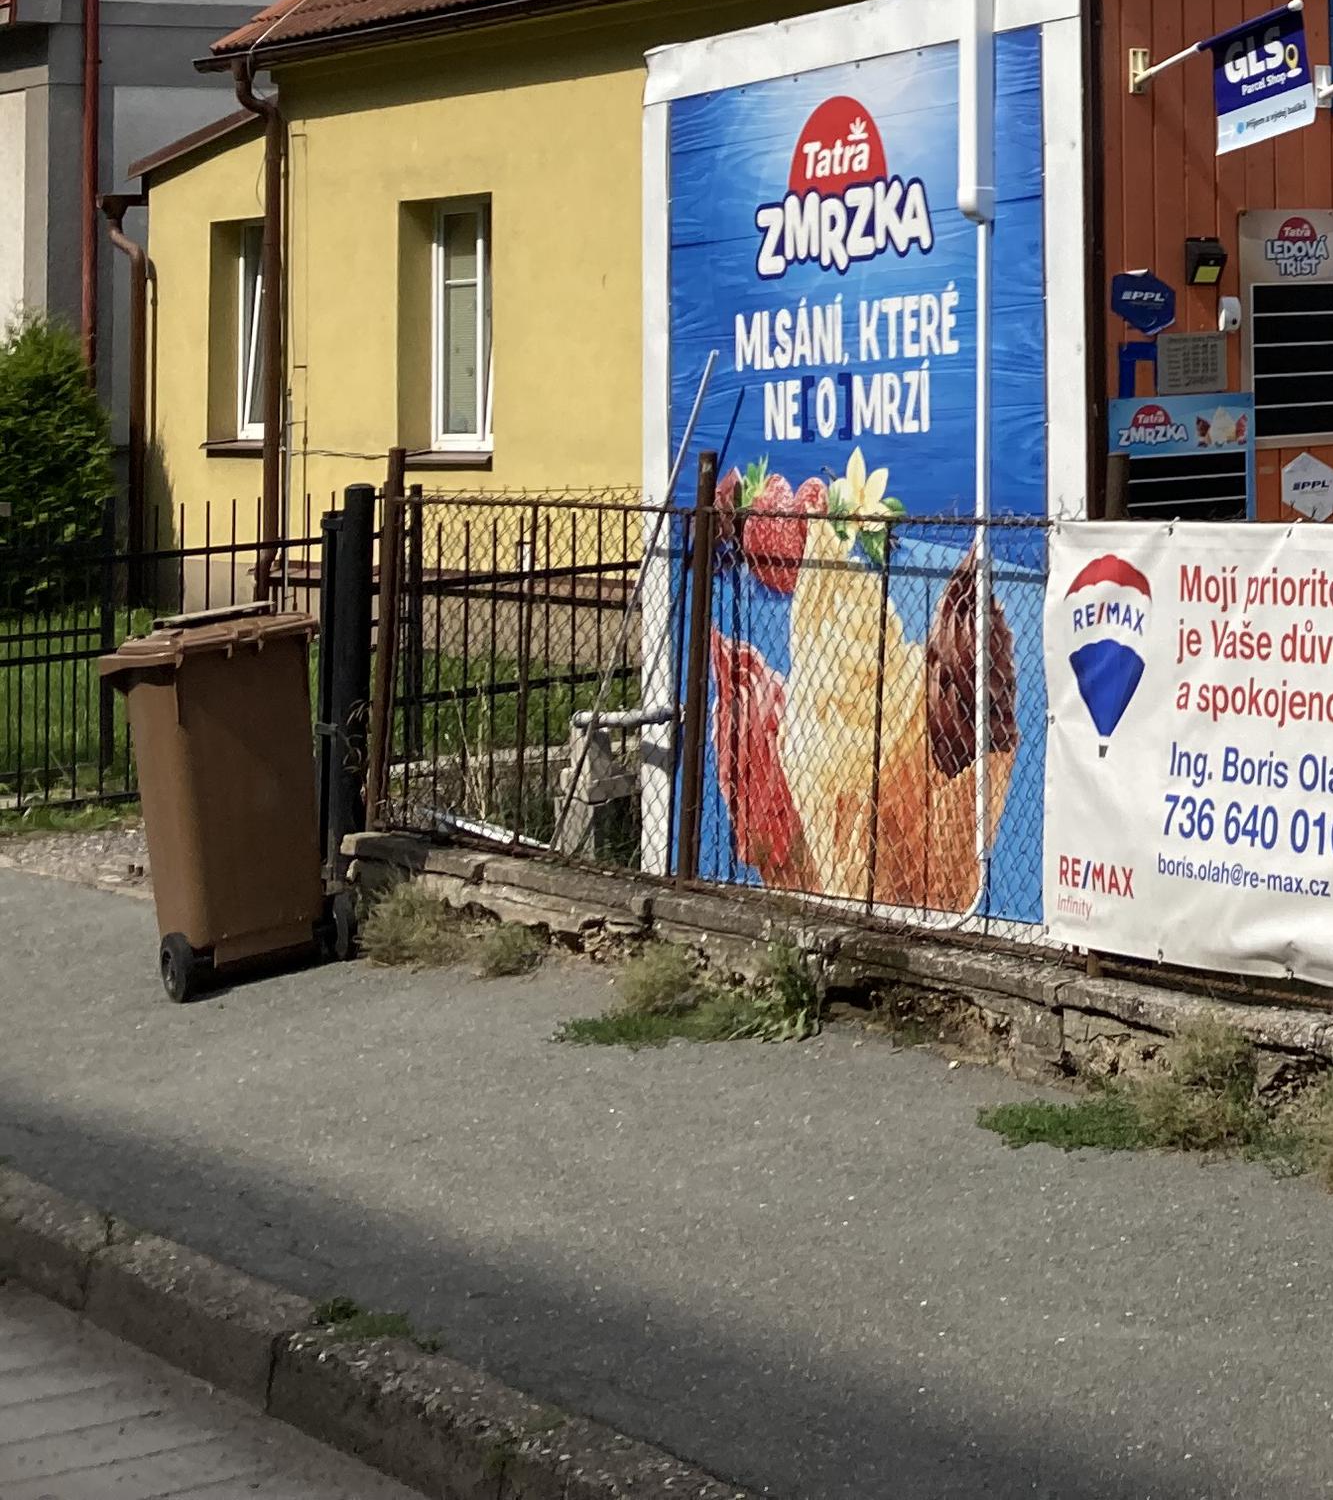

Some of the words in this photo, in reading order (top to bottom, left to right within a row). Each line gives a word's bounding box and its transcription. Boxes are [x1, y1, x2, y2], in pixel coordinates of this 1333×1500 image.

[1224, 26, 1284, 84] GLS
[802, 130, 870, 180] Tatra
[756, 177, 933, 277] ZMRZKA
[1266, 236, 1328, 260] LEDOVÁ
[1130, 290, 1165, 302] PPL
[735, 292, 850, 372] MLSÁNÍ,
[860, 280, 960, 362] KTERÉ
[1118, 423, 1188, 447] ZMRZKA
[1300, 480, 1330, 490] PPL
[1179, 564, 1239, 613] Mojí
[1073, 602, 1145, 636] RE/MAX
[1176, 618, 1202, 665] je
[1211, 619, 1273, 661] Vaše
[1176, 681, 1191, 711] a
[1169, 741, 1213, 788] Ing.
[1222, 746, 1289, 789] Boris
[1163, 794, 1216, 842] 736
[1224, 801, 1279, 850] 640
[1059, 854, 1135, 899] RE/MAX
[1157, 852, 1331, 898] boris.olah@re-max.cz
[1056, 894, 1093, 921] Infinity
